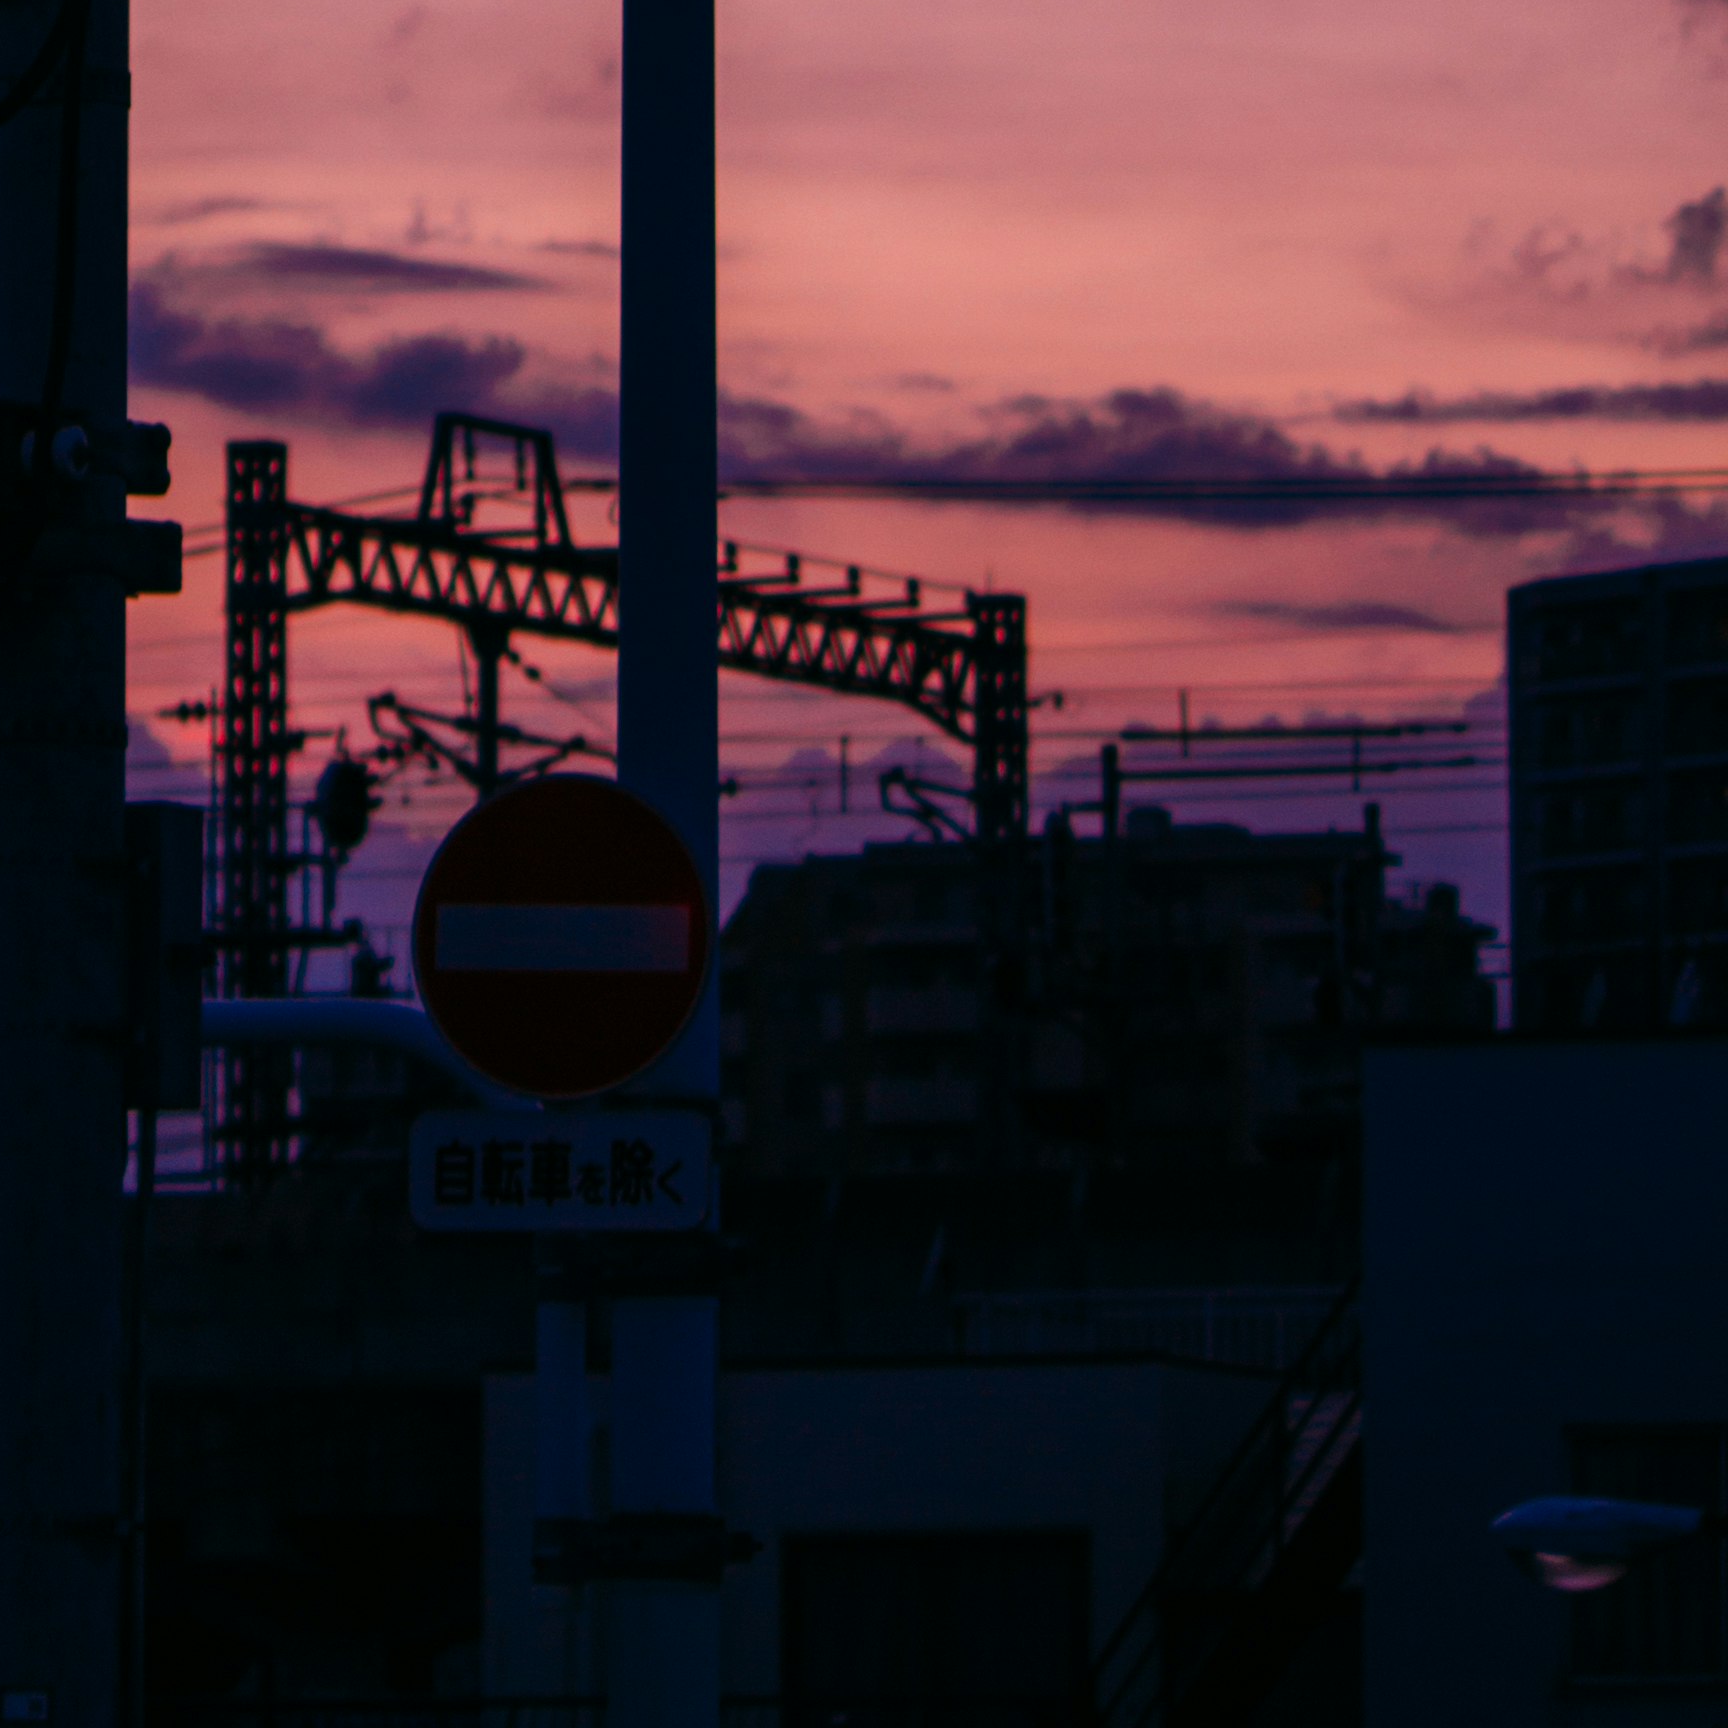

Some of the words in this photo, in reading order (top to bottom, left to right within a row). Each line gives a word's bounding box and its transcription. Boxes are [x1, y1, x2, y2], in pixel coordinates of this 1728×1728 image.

[435, 1138, 684, 1206] 自転車を除く
